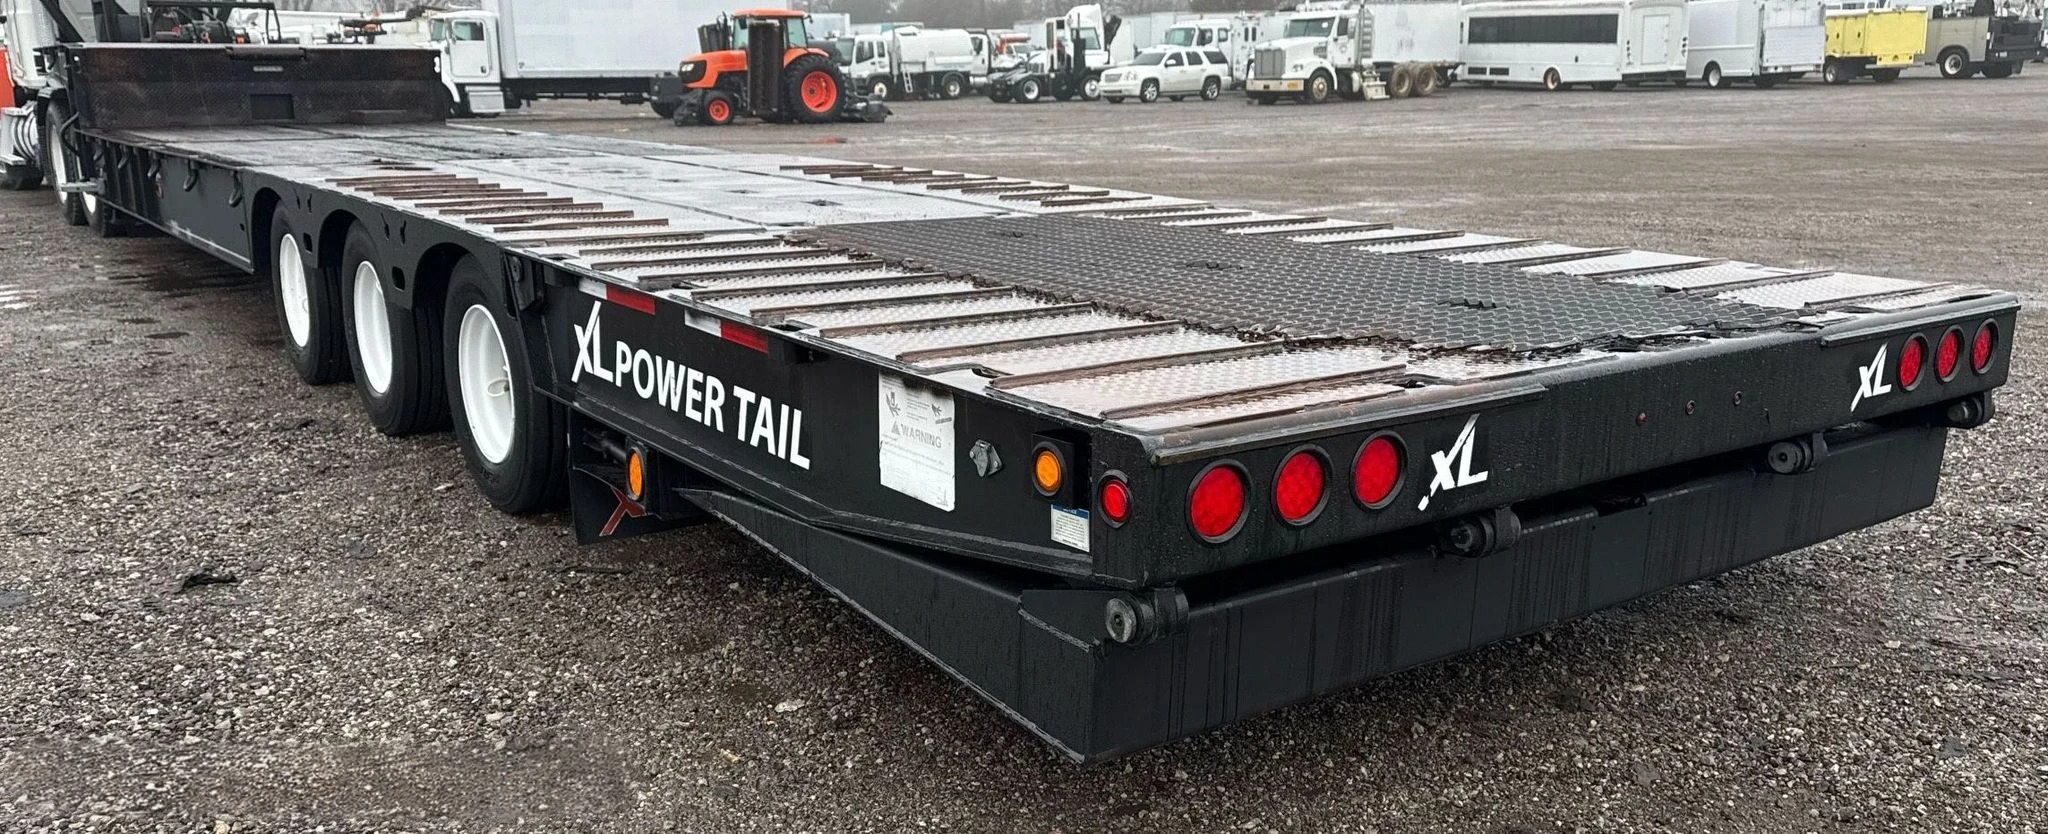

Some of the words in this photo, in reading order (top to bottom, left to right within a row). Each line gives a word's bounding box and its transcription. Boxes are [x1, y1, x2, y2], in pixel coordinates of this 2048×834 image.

[615, 340, 725, 433] POWER
[733, 385, 810, 470] TAIL
[1849, 342, 1892, 412] XL
[901, 423, 942, 449] WARNING
[1417, 413, 1489, 511] XL
